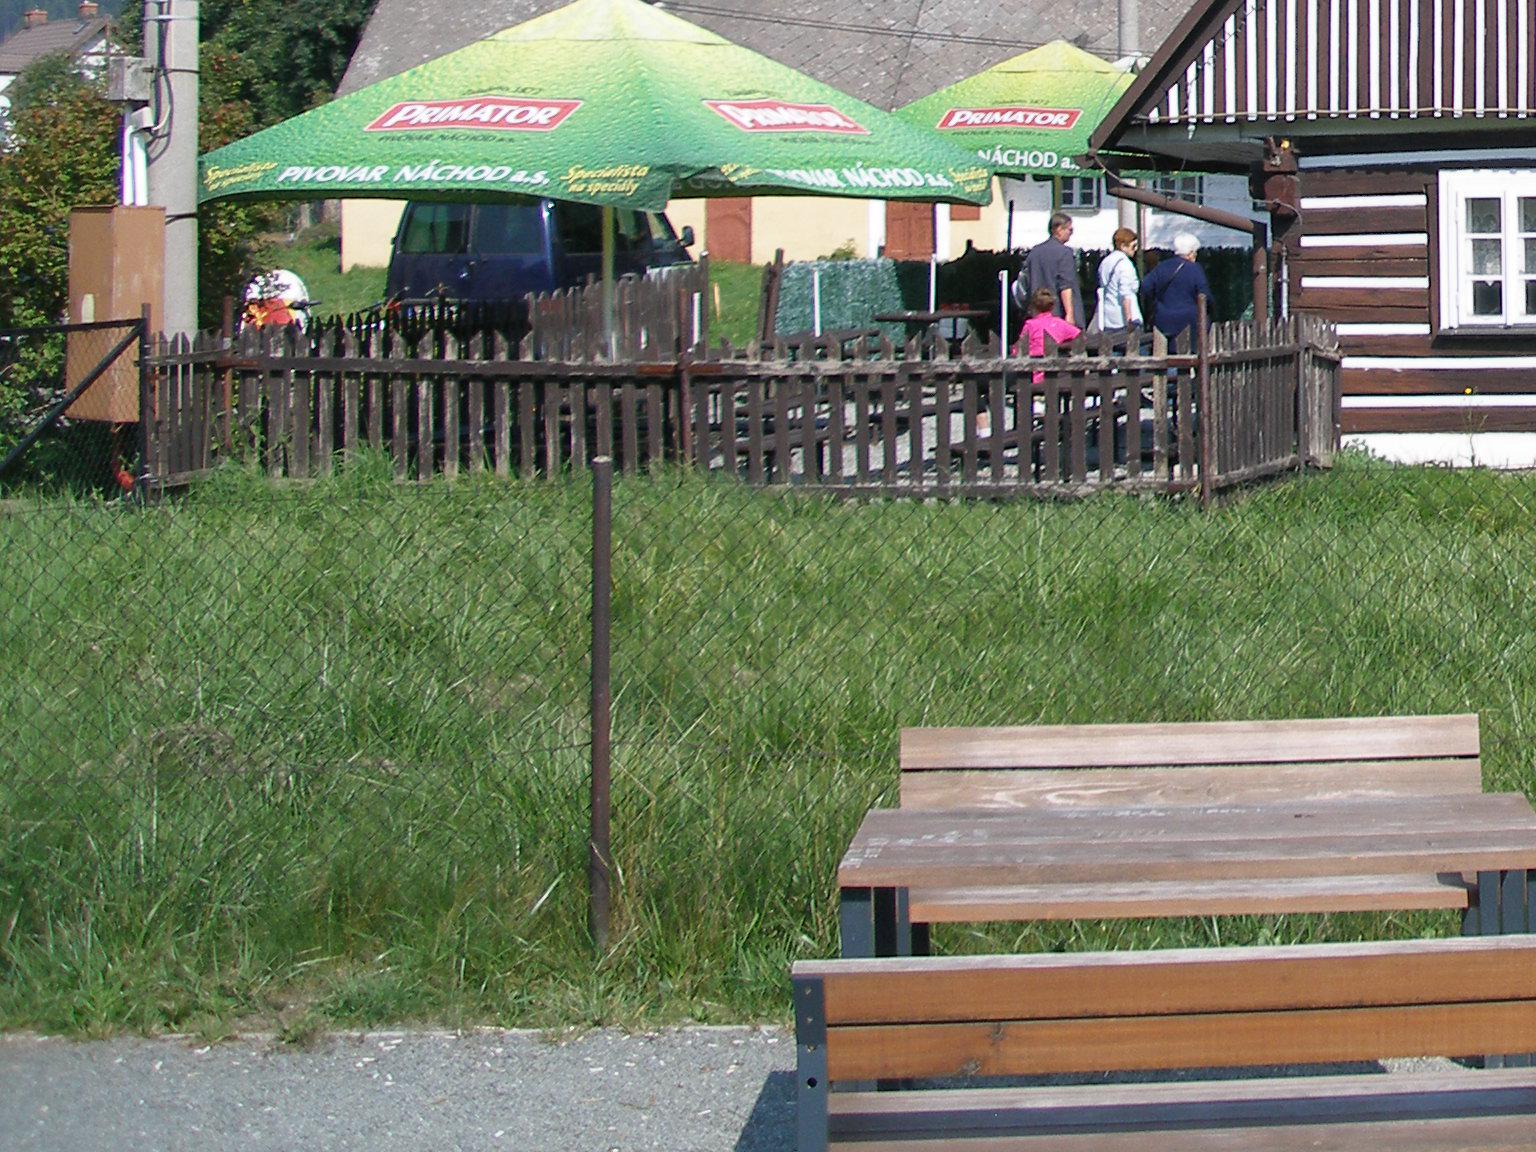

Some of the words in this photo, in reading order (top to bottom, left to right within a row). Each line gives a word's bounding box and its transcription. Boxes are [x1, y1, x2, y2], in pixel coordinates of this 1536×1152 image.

[382, 103, 562, 128] PRIMATOR
[947, 110, 1072, 127] PRIMATOR
[276, 164, 391, 183] PIVOVAR
[393, 159, 513, 183] NÁCHOD
[509, 169, 551, 185] a.s.
[560, 163, 651, 184] Specialista
